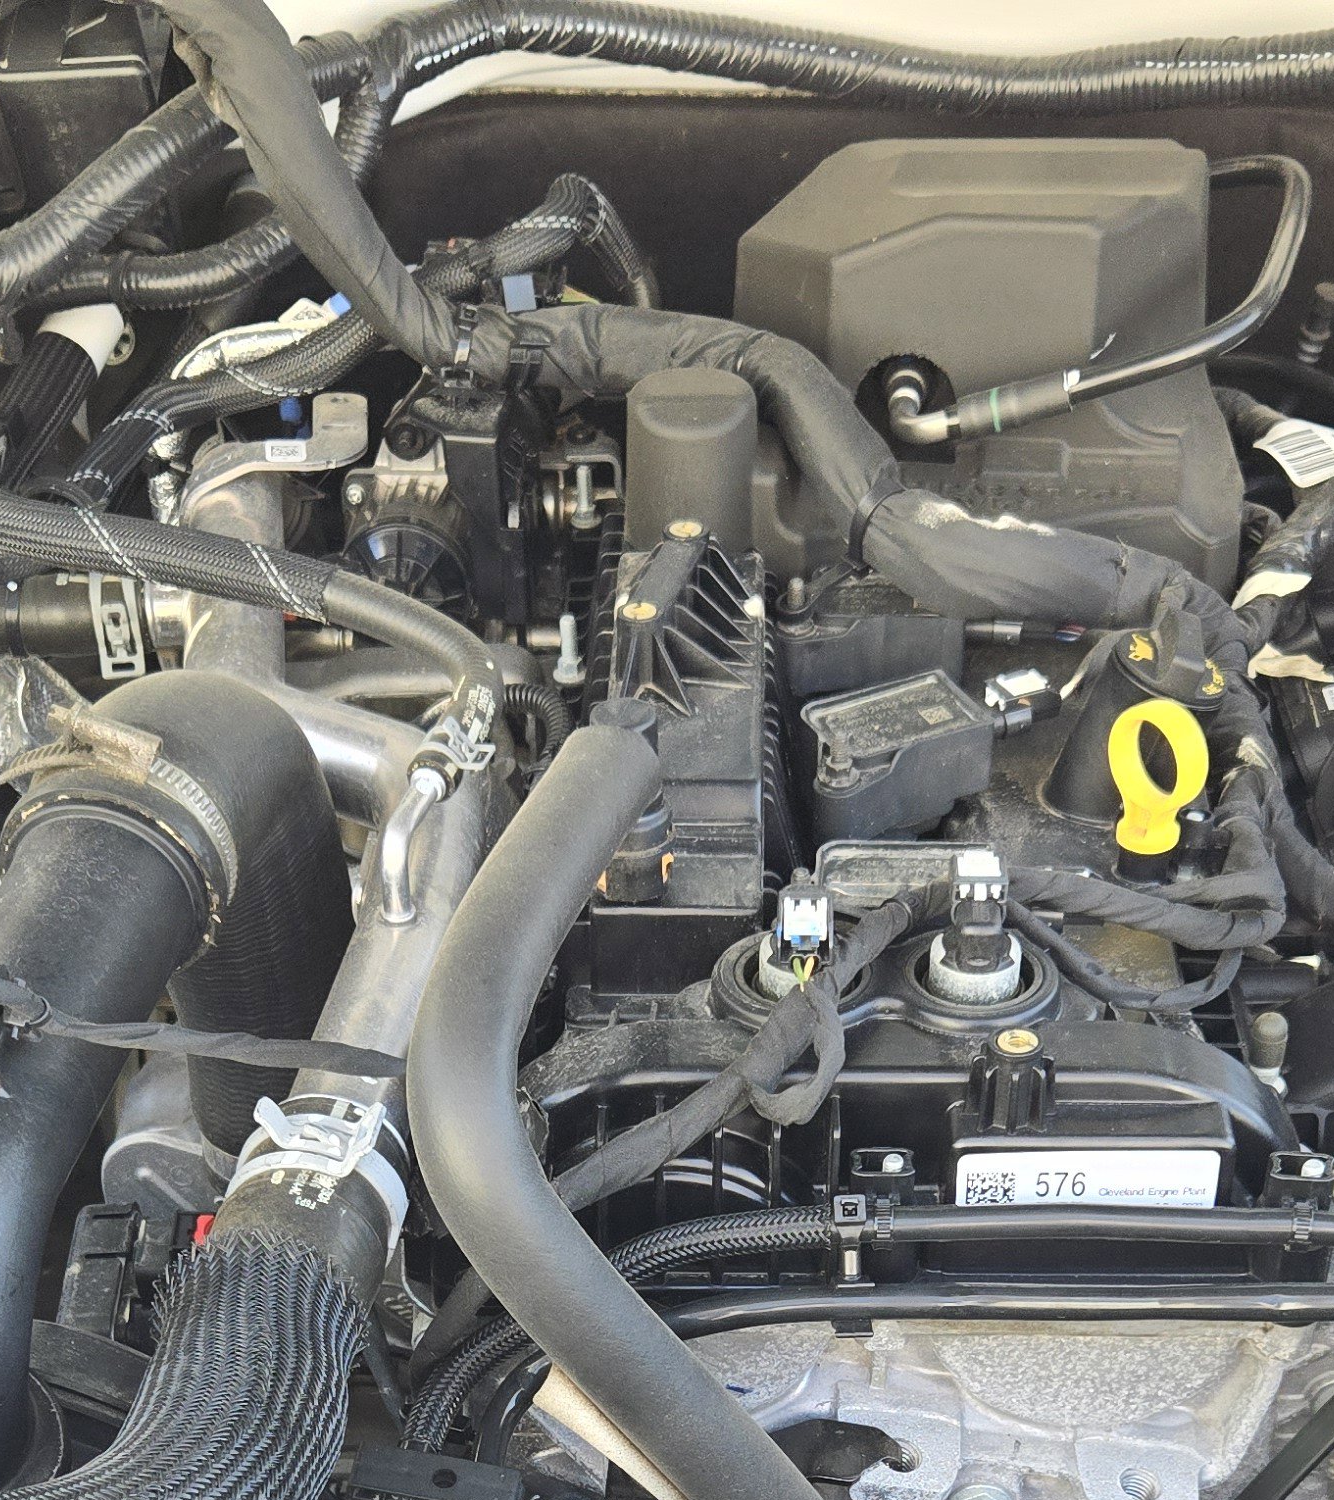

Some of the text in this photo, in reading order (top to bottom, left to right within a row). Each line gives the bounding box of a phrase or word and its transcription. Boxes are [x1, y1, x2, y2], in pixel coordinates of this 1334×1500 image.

[1035, 1172, 1086, 1197] 576
[1098, 1187, 1206, 1198] Cleveland Engine Plant
